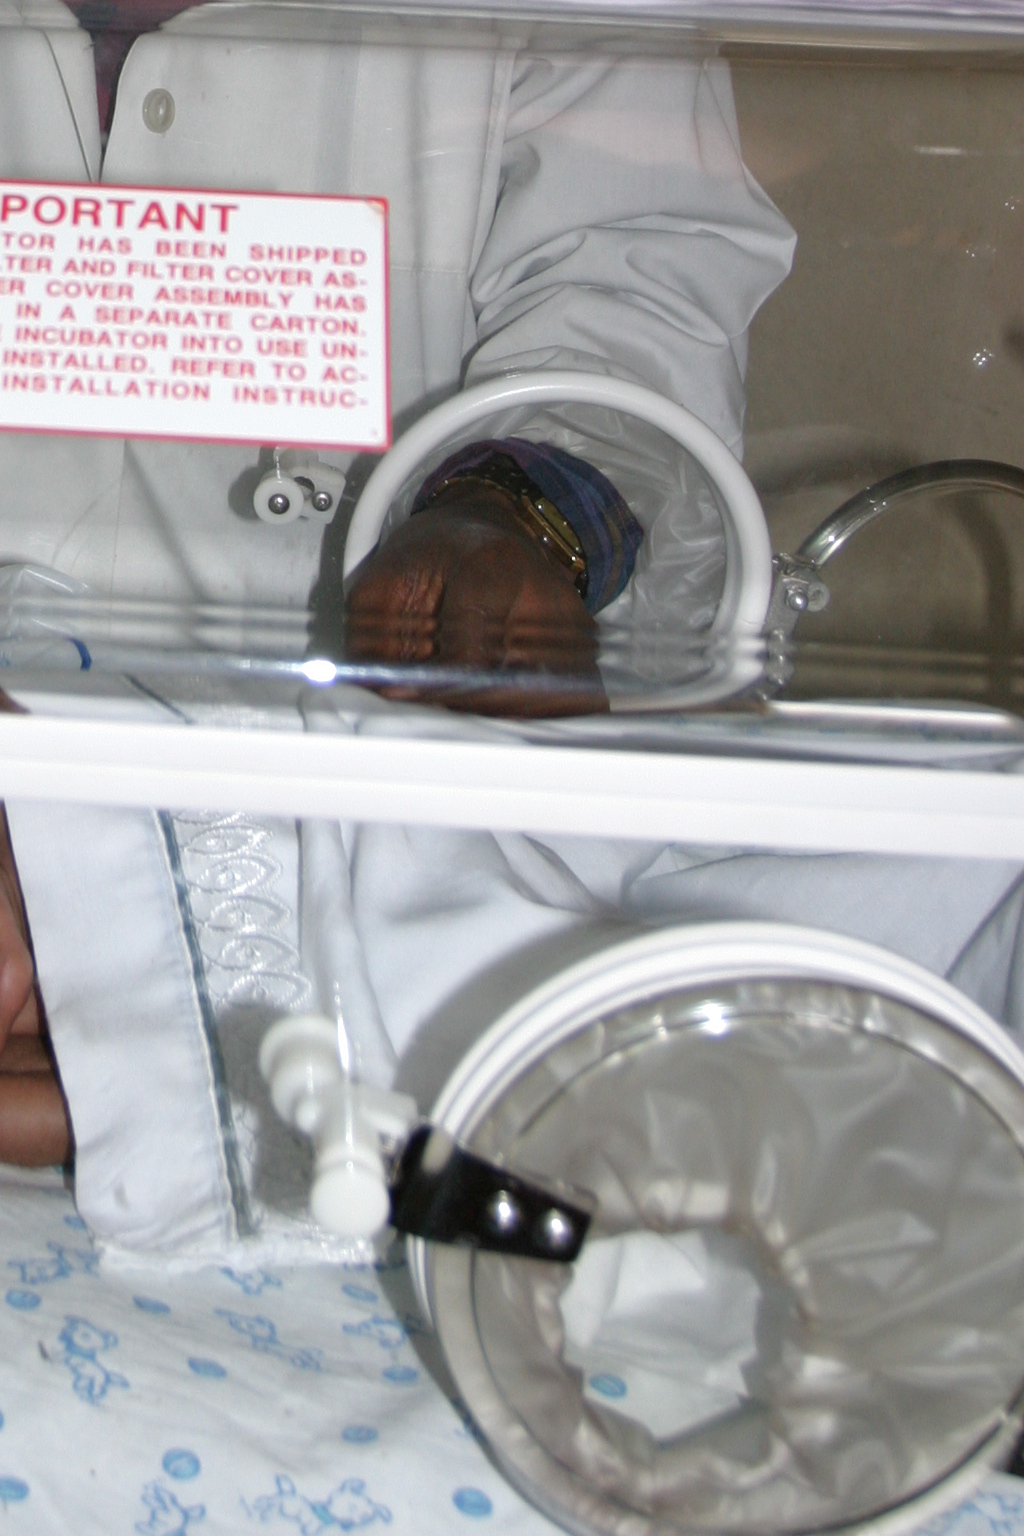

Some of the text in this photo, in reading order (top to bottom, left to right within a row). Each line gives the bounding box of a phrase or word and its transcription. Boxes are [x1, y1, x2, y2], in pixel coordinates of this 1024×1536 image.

[77, 238, 132, 255] HAS
[154, 241, 227, 259] BEEN
[249, 245, 367, 266] SHIPPED
[63, 259, 116, 277] AND
[126, 262, 214, 281] FILTER
[224, 267, 313, 286] COVER
[324, 272, 369, 289] AS-
[45, 282, 134, 300] COVER
[154, 287, 292, 309] ASSEMBLY
[314, 295, 367, 313] HAS
[16, 304, 41, 320] IN
[60, 306, 76, 321] A
[95, 307, 230, 330] SEPARATE
[249, 315, 367, 336] CARTON.
[15, 327, 168, 349] INCUBATOR
[181, 336, 243, 354] INTO
[256, 340, 306, 358] USE
[321, 343, 369, 360] UN-
[2, 350, 155, 373] INSTALLED.
[170, 358, 260, 378] REFER
[273, 363, 307, 381] TO
[322, 366, 369, 384] AC-
[2, 375, 211, 400] INSTALLATION
[233, 387, 369, 408] INSTRUC-
